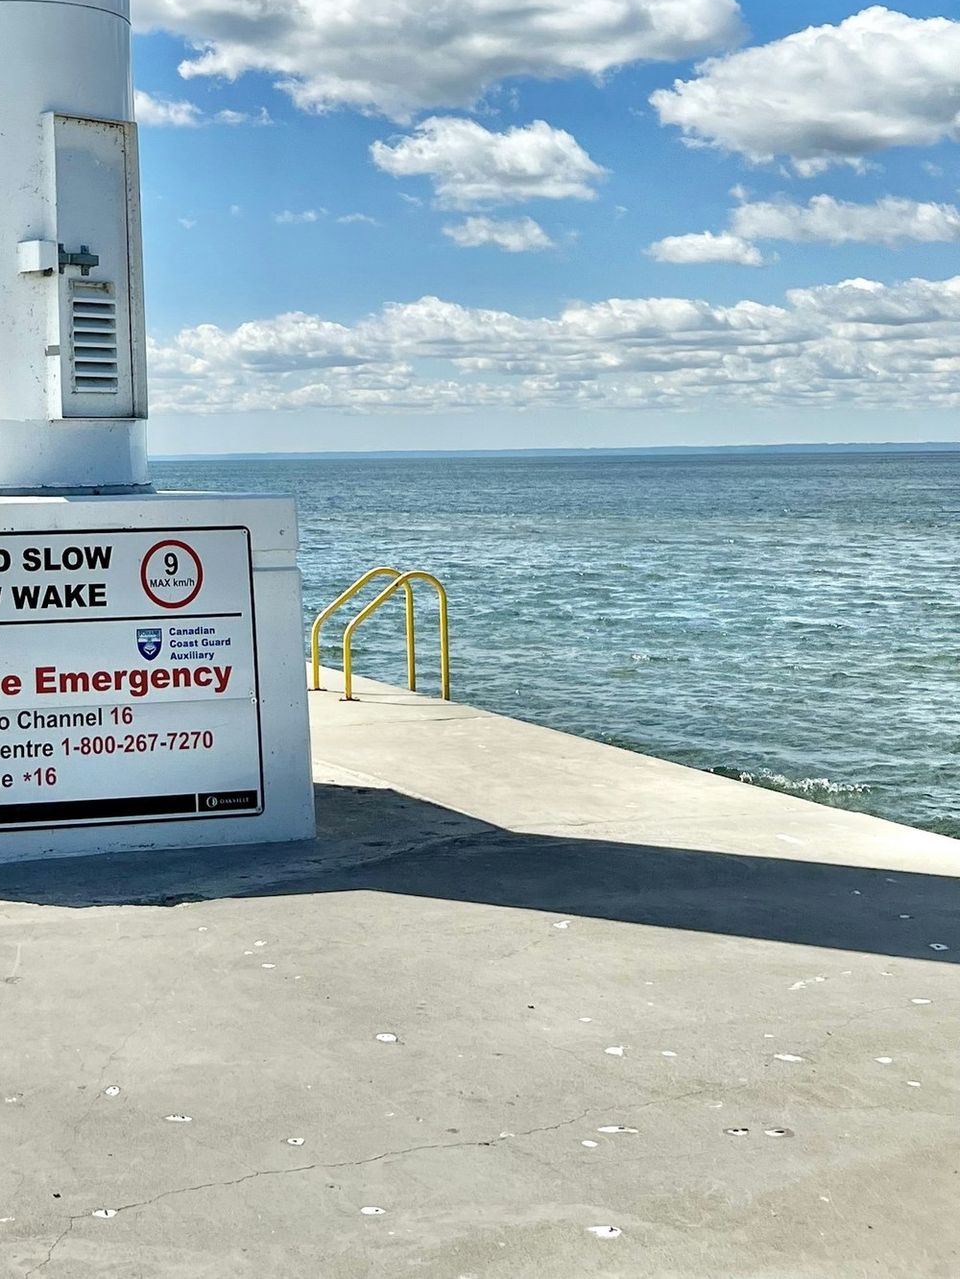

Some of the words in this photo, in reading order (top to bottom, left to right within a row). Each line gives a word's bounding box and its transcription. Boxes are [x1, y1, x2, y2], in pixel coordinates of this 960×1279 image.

[22, 546, 113, 571] SLOW
[163, 552, 179, 576] 9
[149, 578, 171, 589] MAX
[172, 577, 196, 588] km/h
[12, 583, 108, 610] WAKE
[168, 626, 216, 637] Canadian
[169, 639, 198, 649] Coast
[201, 637, 231, 648] Guard
[170, 651, 215, 661] Auxiliary
[34, 665, 233, 697] Emergency
[16, 708, 103, 730] Channel
[110, 706, 134, 726] 16
[61, 730, 214, 756] 1-800-267-7270
